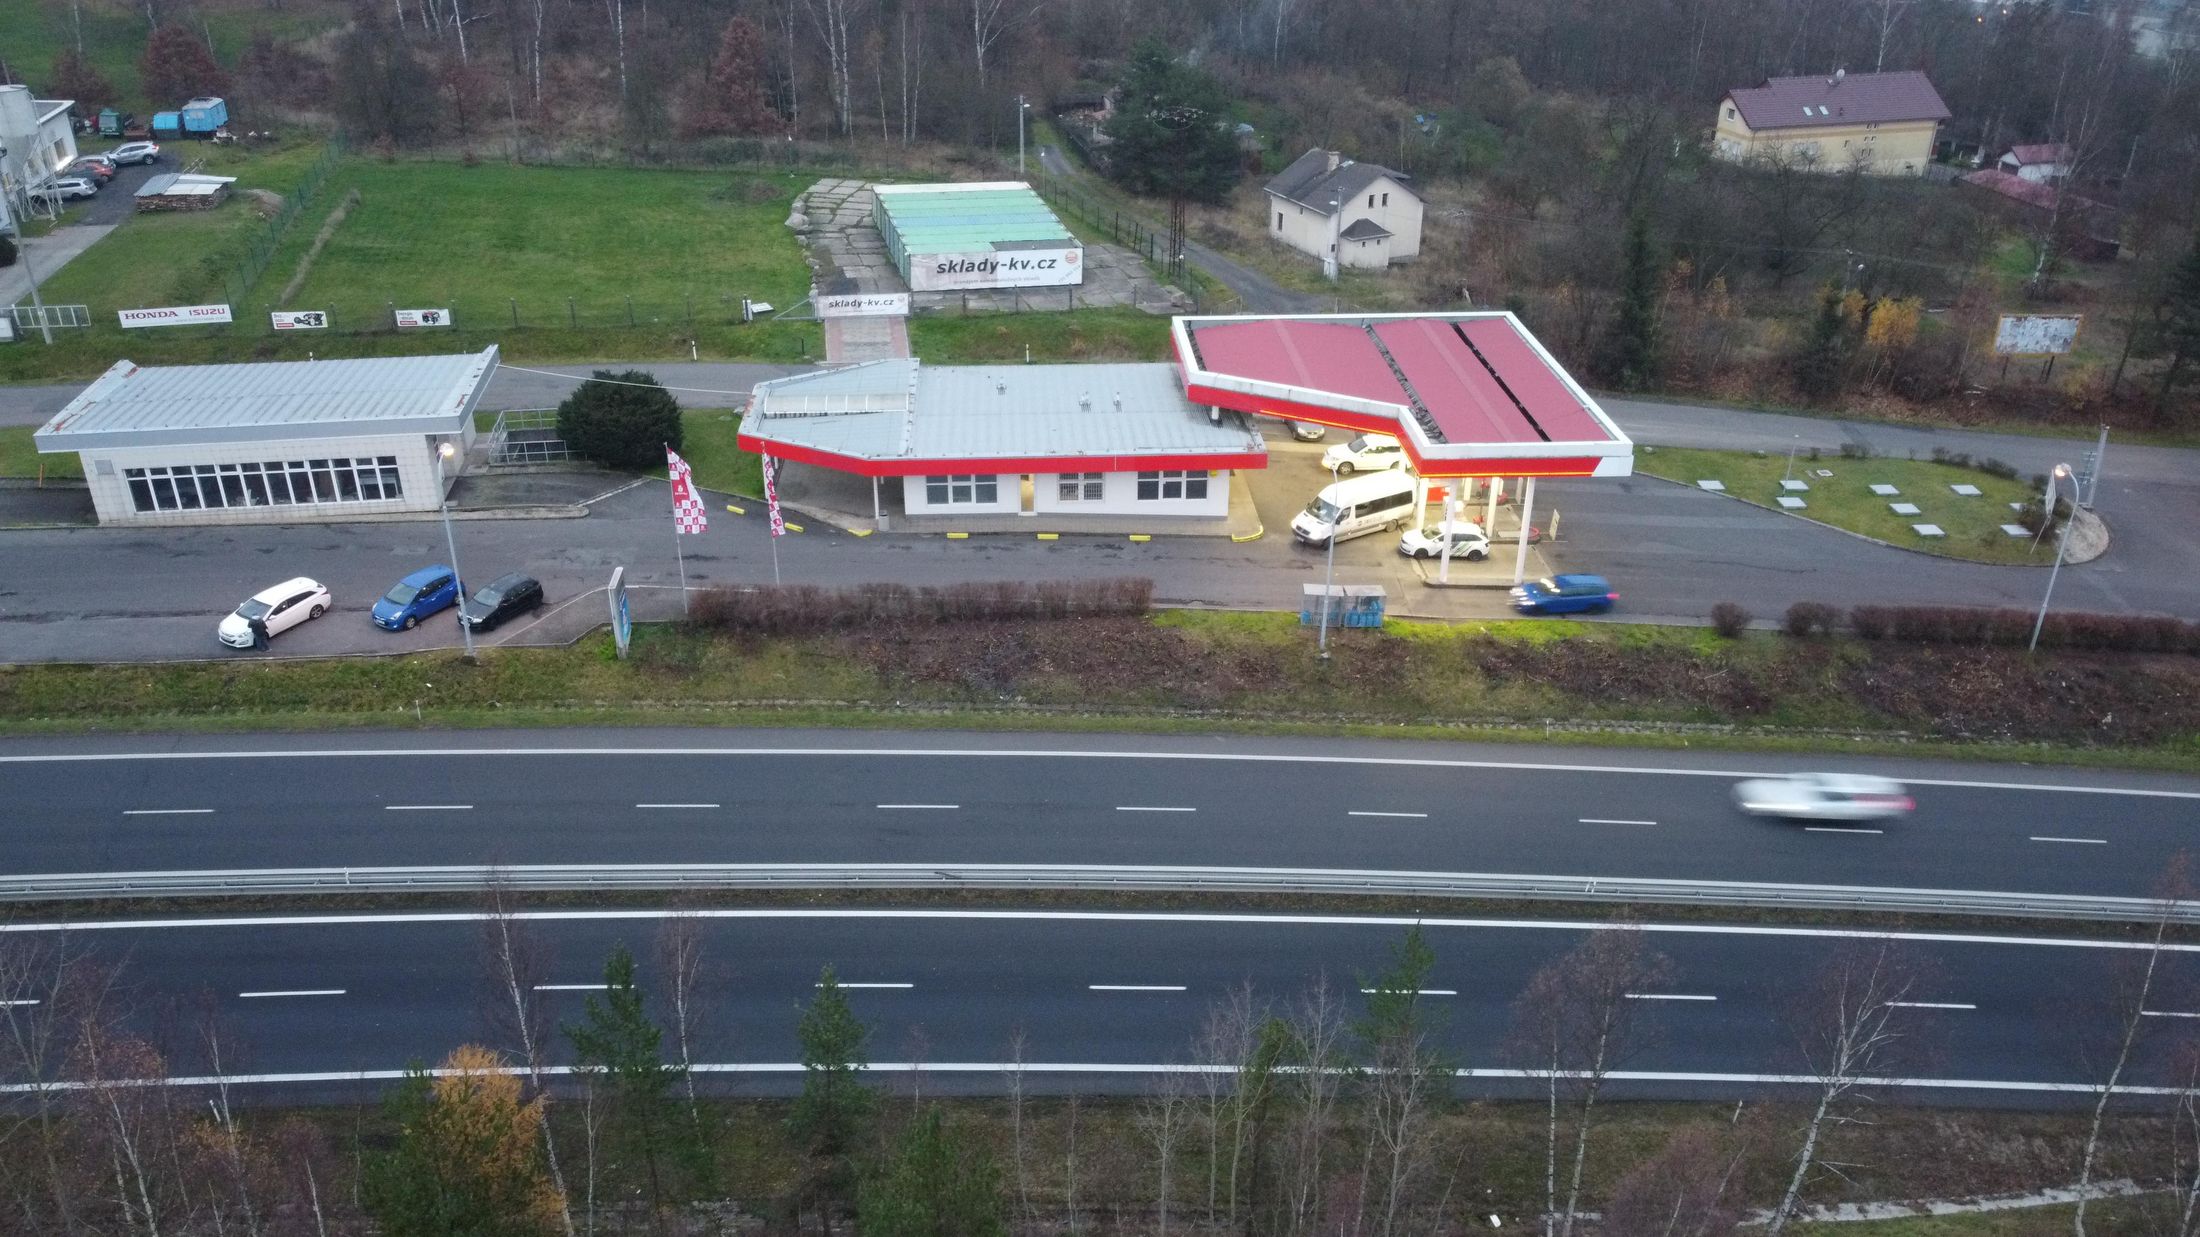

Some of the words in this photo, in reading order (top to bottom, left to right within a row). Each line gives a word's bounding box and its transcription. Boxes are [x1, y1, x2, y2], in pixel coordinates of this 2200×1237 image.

[936, 257, 1057, 275] sklady-kv.cz
[828, 299, 895, 309] sklady-kv.cz
[124, 310, 179, 320] HONDA
[189, 308, 226, 316] ISUZU
